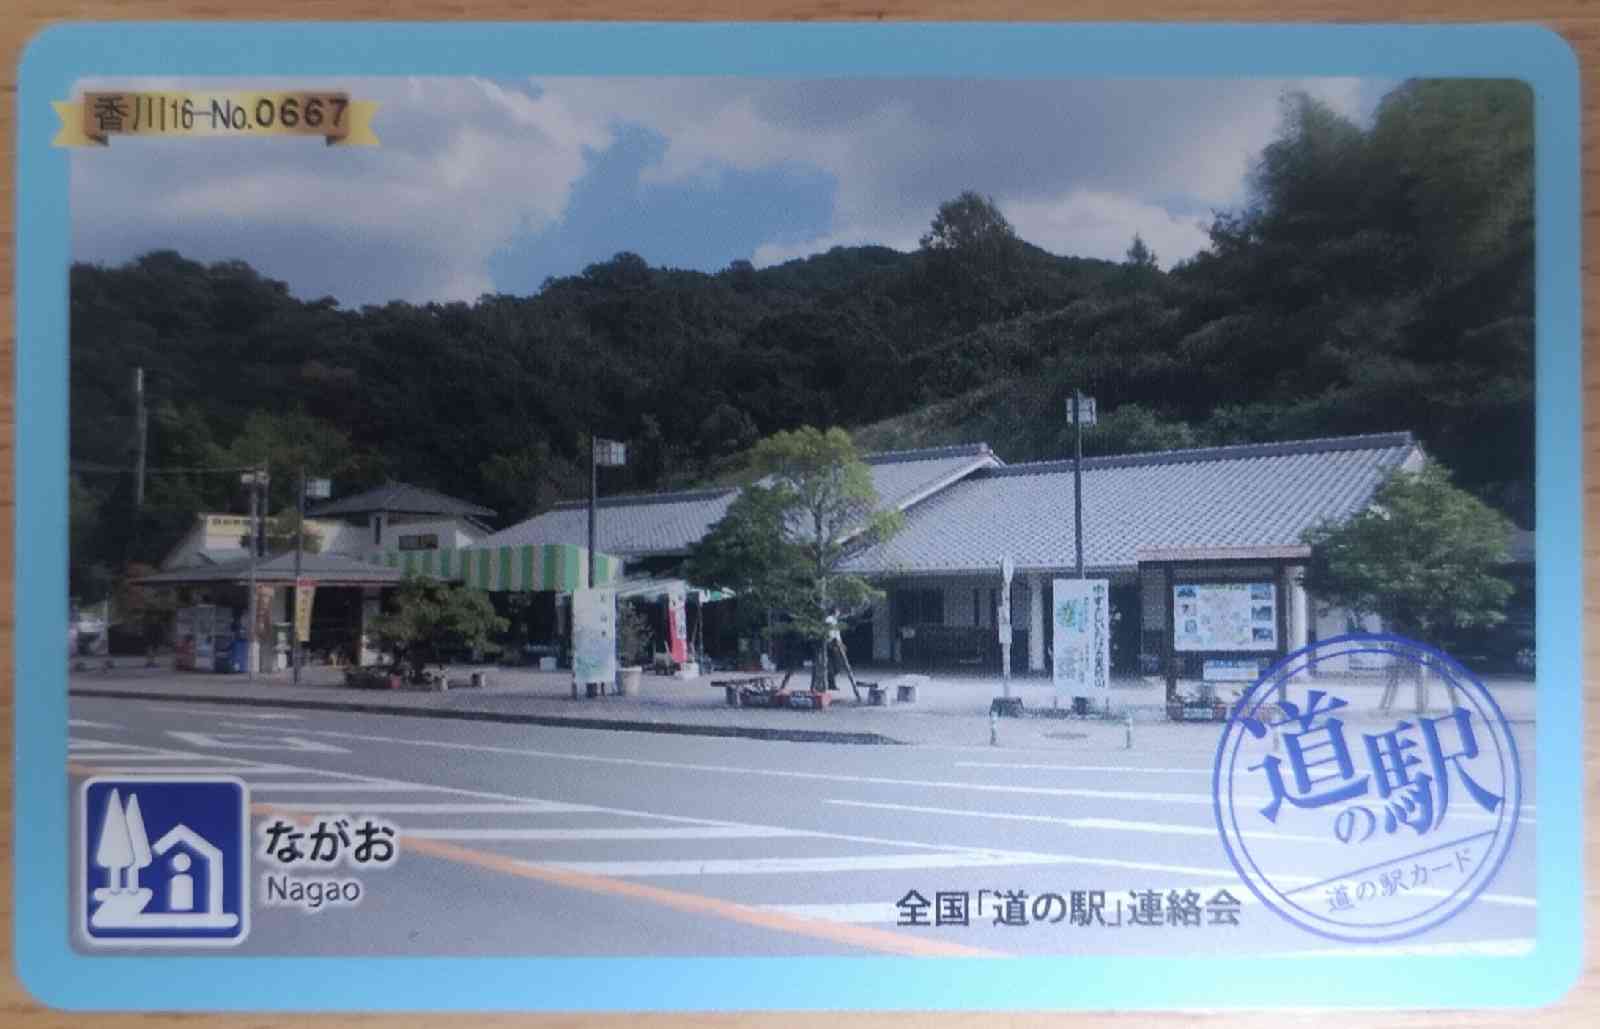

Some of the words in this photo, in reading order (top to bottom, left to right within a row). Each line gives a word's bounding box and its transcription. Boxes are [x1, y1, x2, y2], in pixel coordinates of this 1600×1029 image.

[1240, 690, 1505, 844] 道の駅
[265, 820, 395, 863] ながお
[267, 876, 361, 907] Nagao
[1324, 848, 1473, 913] 道の駅カード
[895, 888, 1242, 927] 全国「道の駅」連絡会
